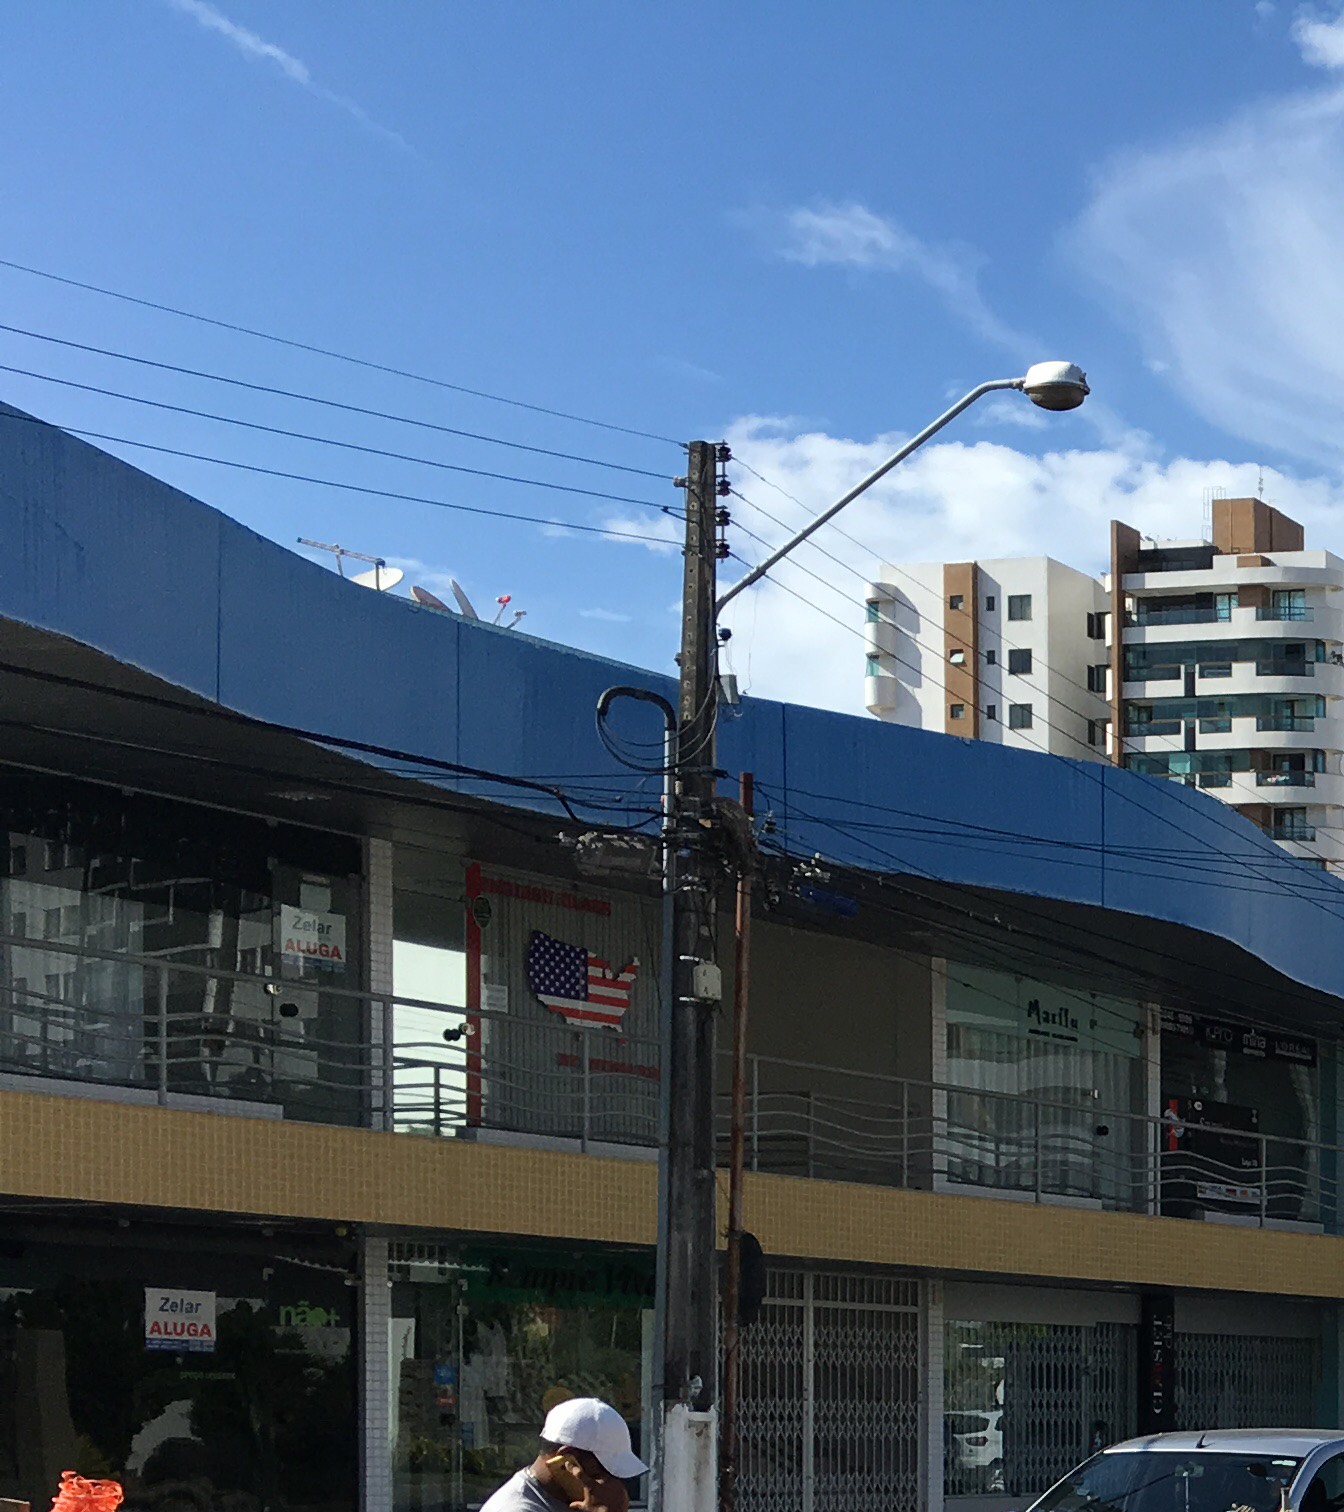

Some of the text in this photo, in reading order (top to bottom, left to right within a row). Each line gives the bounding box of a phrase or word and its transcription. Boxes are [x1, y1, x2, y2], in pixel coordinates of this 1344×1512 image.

[292, 915, 332, 935] Zelar
[285, 938, 342, 959] ALUGA
[158, 1296, 202, 1314] Zelar
[149, 1320, 213, 1338] ALUGA
